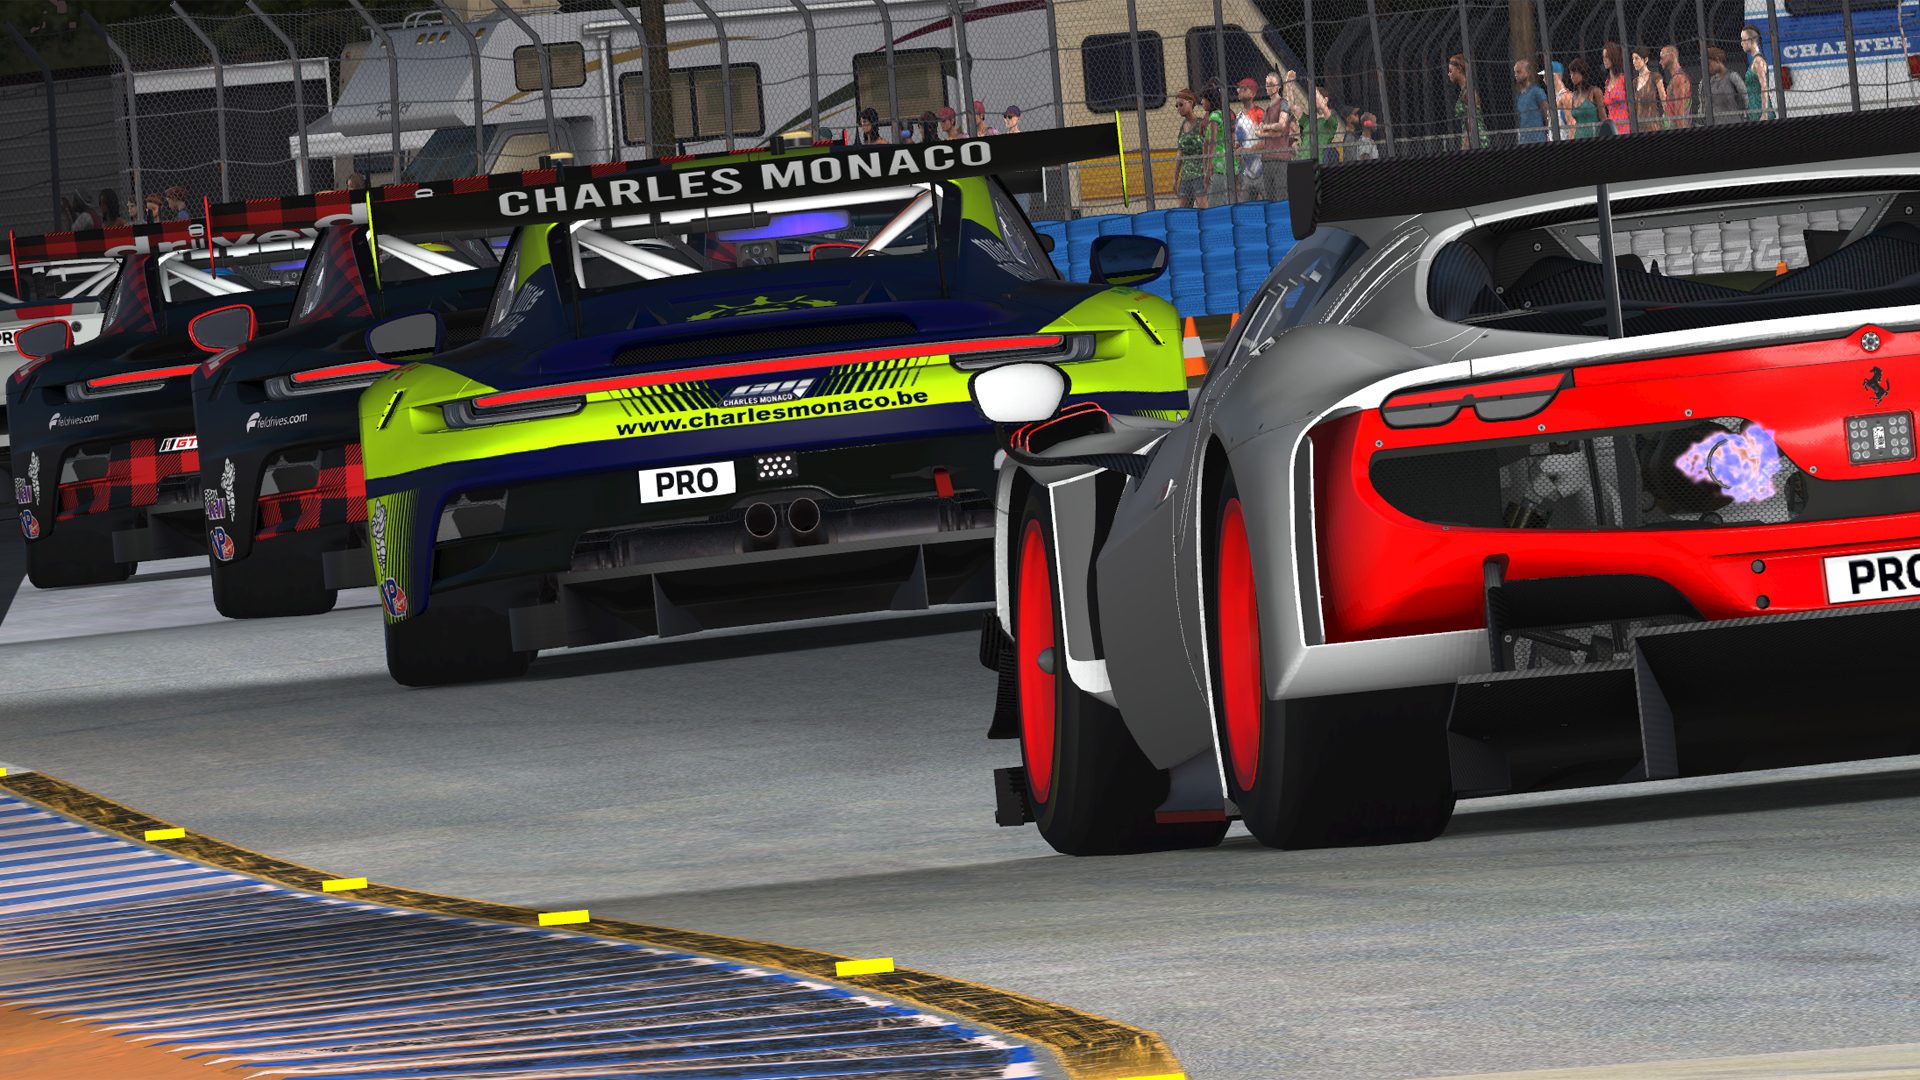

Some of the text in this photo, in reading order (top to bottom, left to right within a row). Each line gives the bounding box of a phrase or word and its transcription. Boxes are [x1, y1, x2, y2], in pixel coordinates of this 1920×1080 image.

[498, 140, 992, 217] CHARLES MONACO
[616, 390, 929, 436] www.charlesmonaco.be
[723, 393, 793, 407] CHARLES MONACO
[655, 467, 719, 498] PRO
